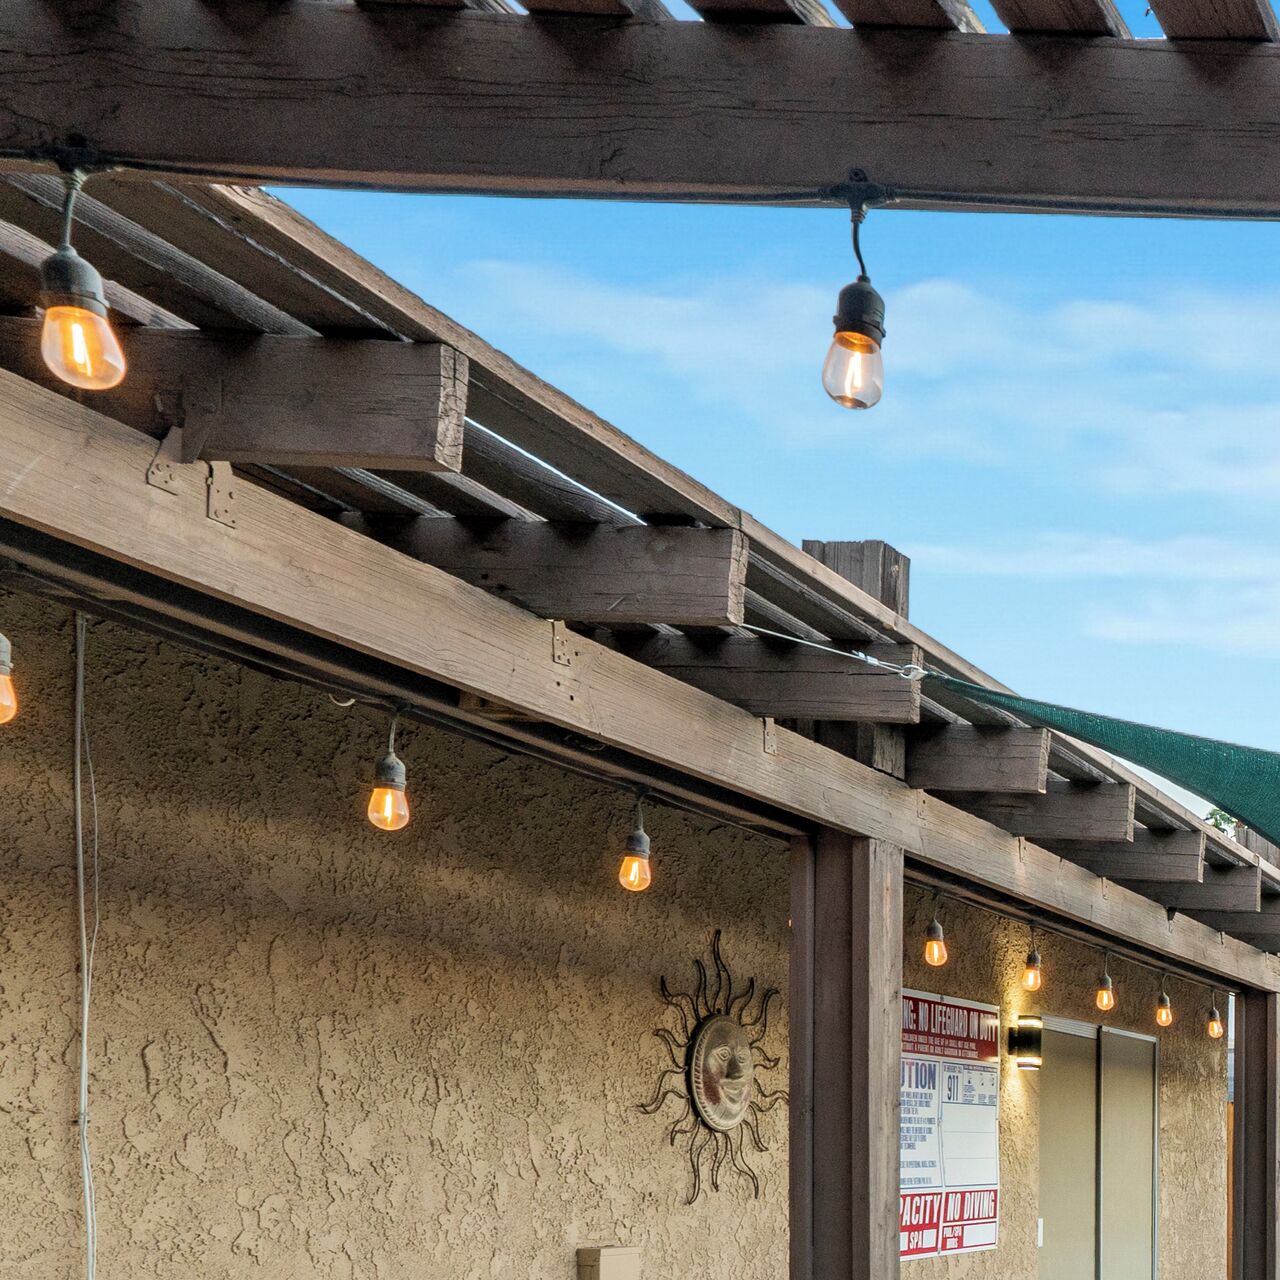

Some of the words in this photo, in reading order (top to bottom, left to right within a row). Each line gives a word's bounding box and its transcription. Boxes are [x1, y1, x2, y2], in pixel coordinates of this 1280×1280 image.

[919, 1001, 929, 1032] NO
[931, 1004, 968, 1038] LIFEGUARD
[970, 1011, 979, 1039] ON
[980, 1013, 996, 1042] DUTY
[947, 1074, 959, 1101] 911
[947, 1193, 961, 1221] NO
[963, 1191, 995, 1220] DIVING
[910, 1231, 923, 1249] SPA
